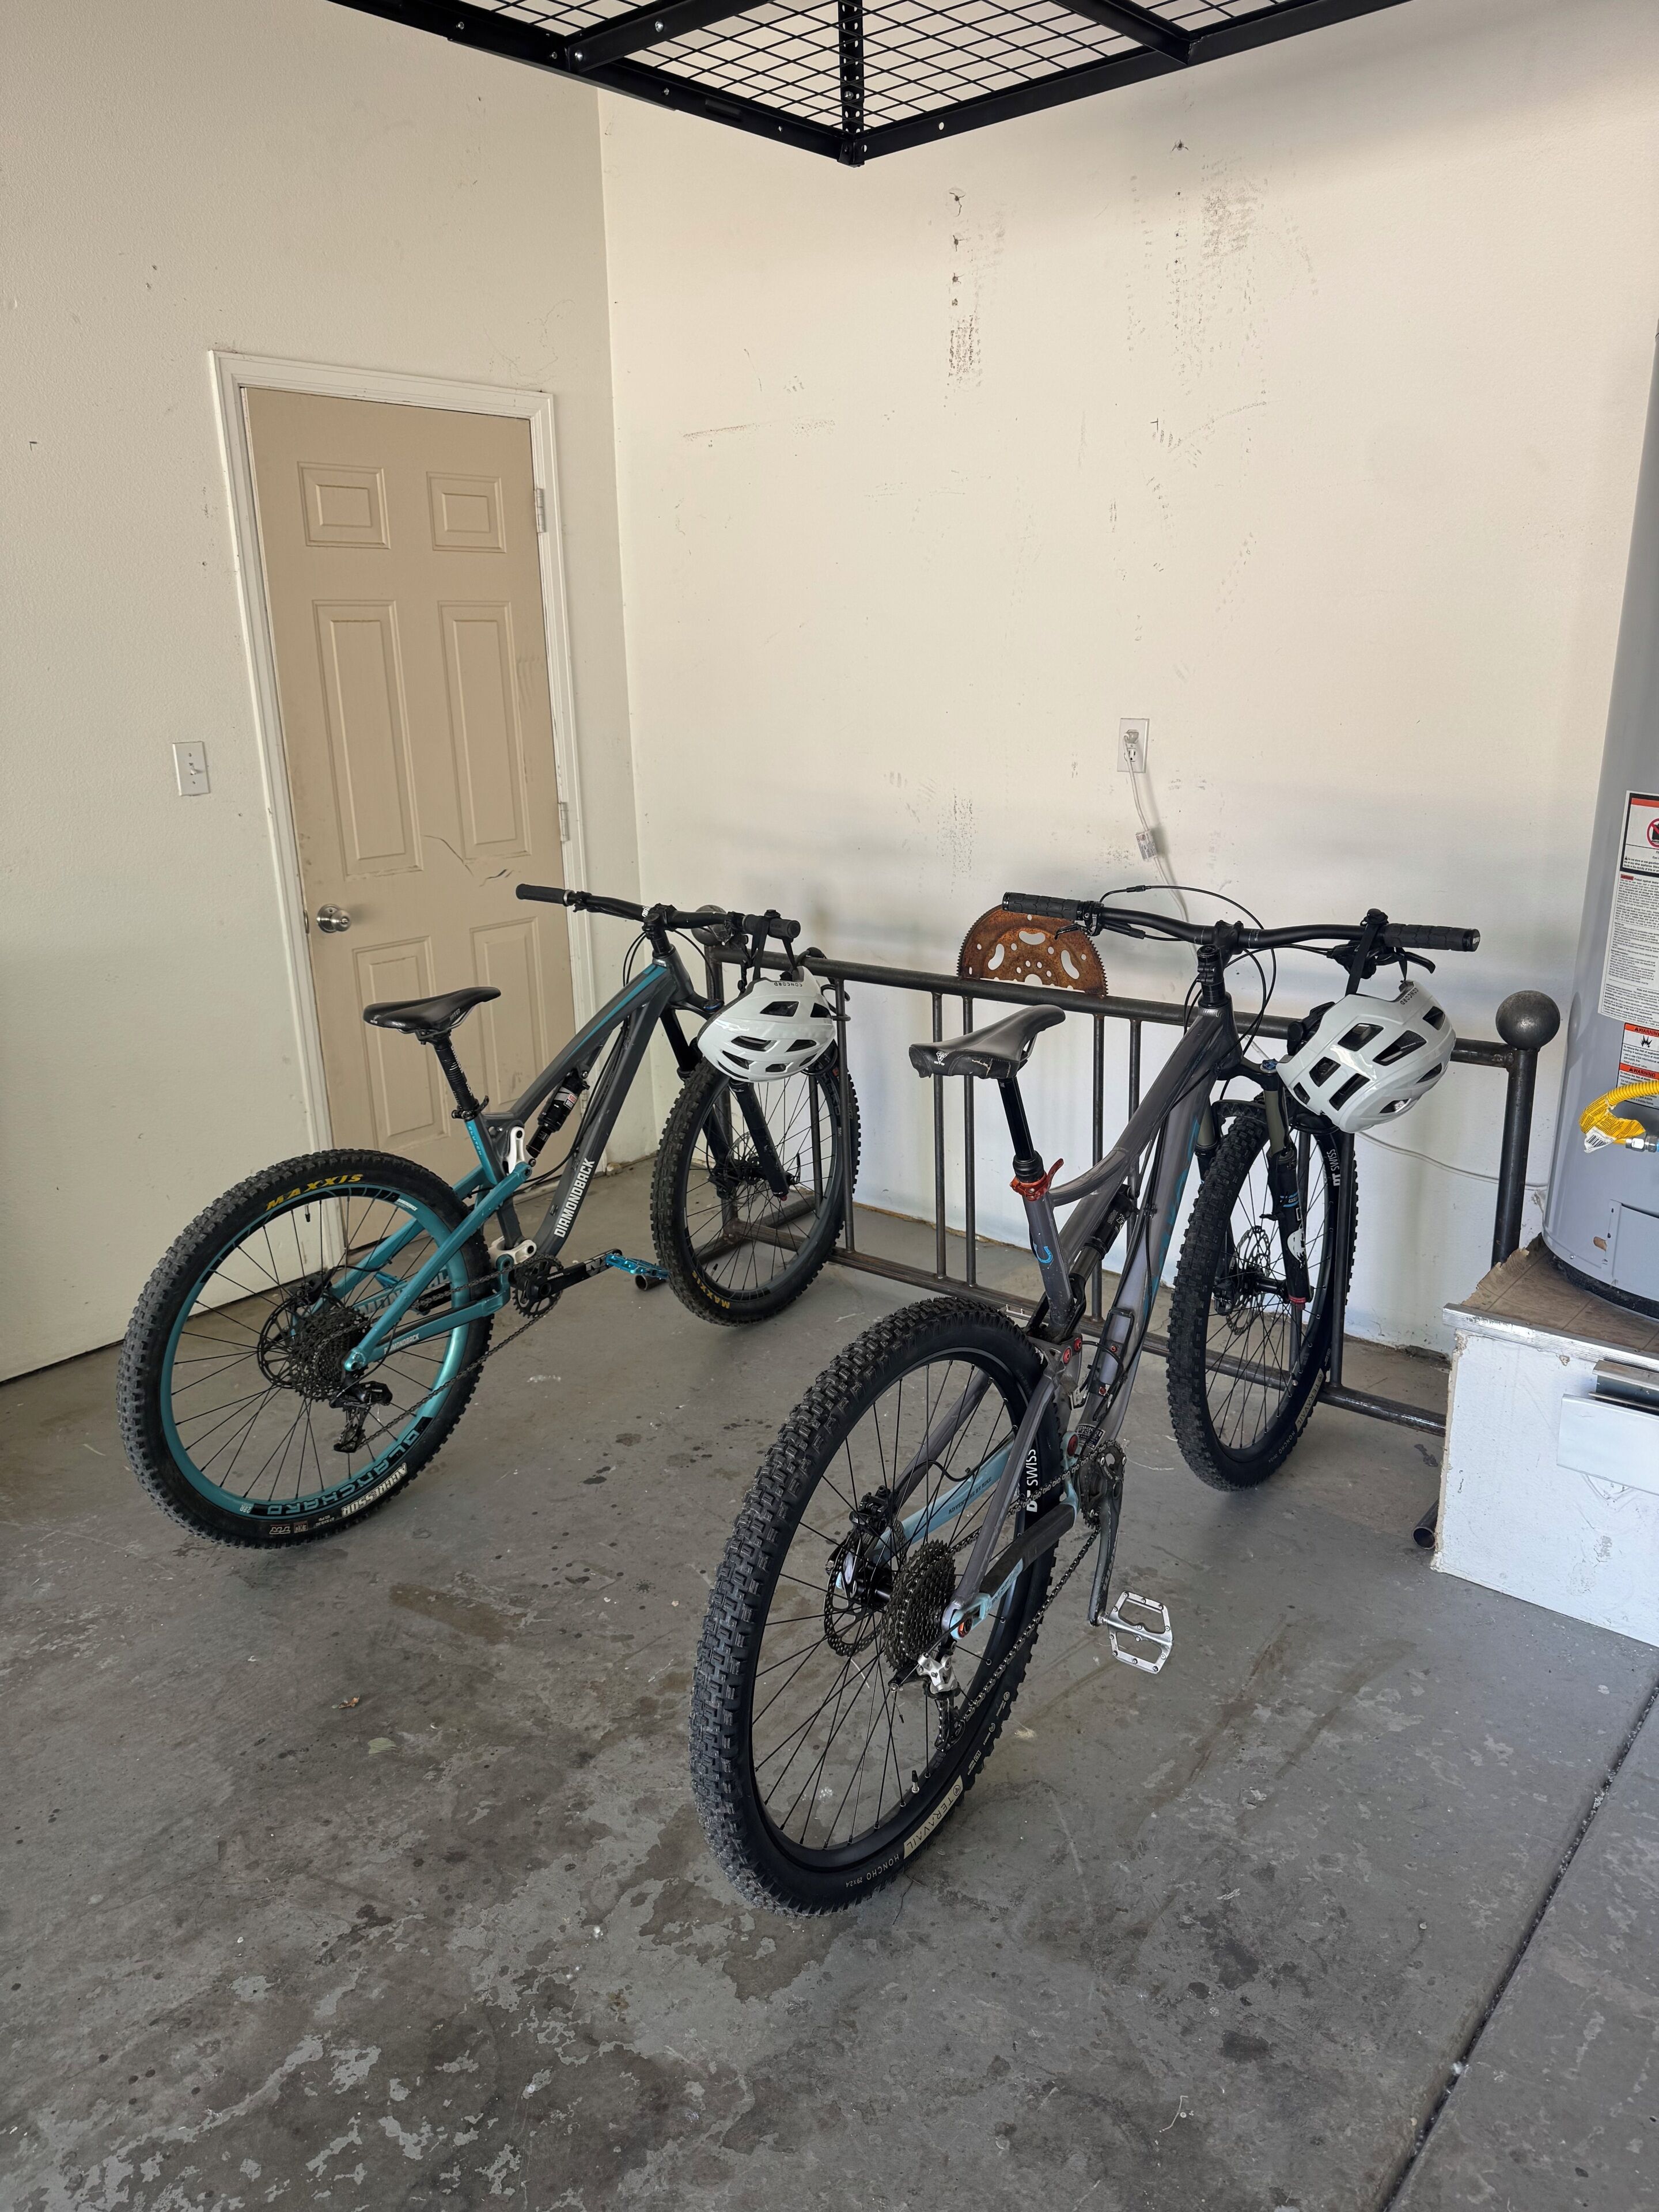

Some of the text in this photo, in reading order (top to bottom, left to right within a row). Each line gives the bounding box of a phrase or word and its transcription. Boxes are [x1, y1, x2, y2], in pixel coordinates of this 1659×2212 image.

[1400, 987, 1419, 1005] CONCORD
[1638, 1028, 1659, 1037] WARNIN
[1633, 1068, 1656, 1078] WARNING
[1326, 1149, 1341, 1186] DT SWISS
[266, 1173, 363, 1211] MAXXIS
[554, 1157, 595, 1238] DIAMONDBACK
[692, 1270, 730, 1309] MAXXIS
[1297, 1384, 1319, 1425] TERAVAIL
[1279, 1430, 1295, 1455] HONCHO
[267, 1429, 421, 1515] BLANCHARD
[980, 1476, 993, 1489] BIKE
[1026, 1449, 1039, 1486] SWISS
[341, 1463, 407, 1518] AGGRESSOR
[906, 1796, 954, 1850] TERAVAIL
[866, 1854, 899, 1880] HONCHO
